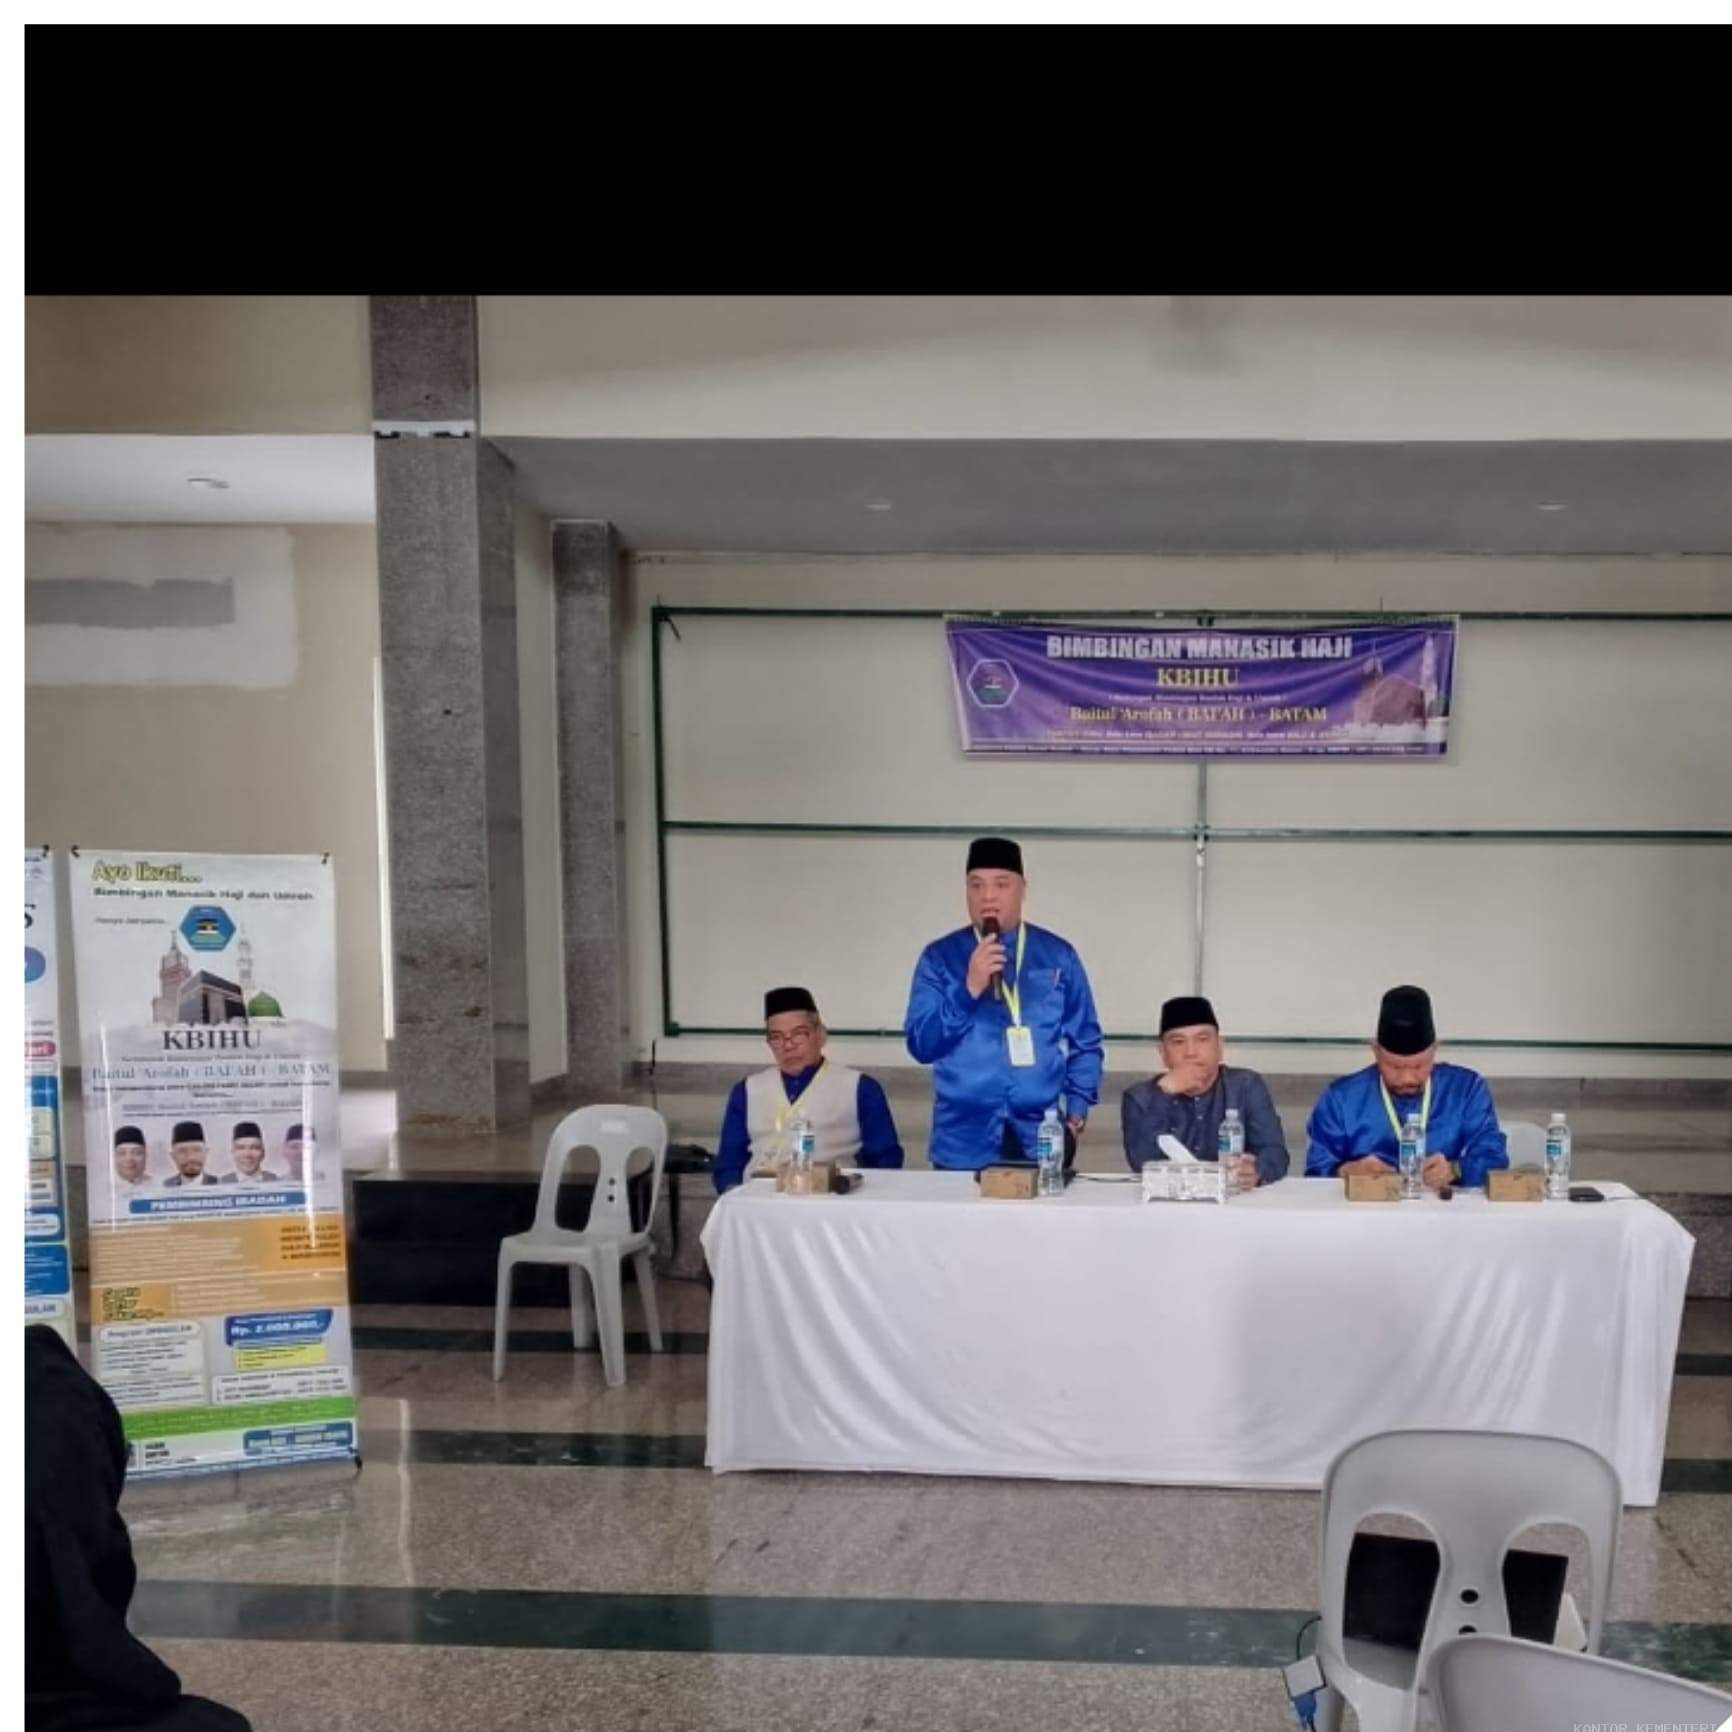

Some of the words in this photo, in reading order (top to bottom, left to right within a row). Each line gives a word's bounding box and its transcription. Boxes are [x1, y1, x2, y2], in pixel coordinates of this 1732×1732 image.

[1046, 635, 1183, 659] BIMBINGAN
[1186, 636, 1297, 659] MANASIK
[1299, 636, 1353, 658] HAJI
[1155, 667, 1241, 689] KBIHU
[1269, 706, 1328, 721] BATAM
[162, 1030, 261, 1051] KBIHU
